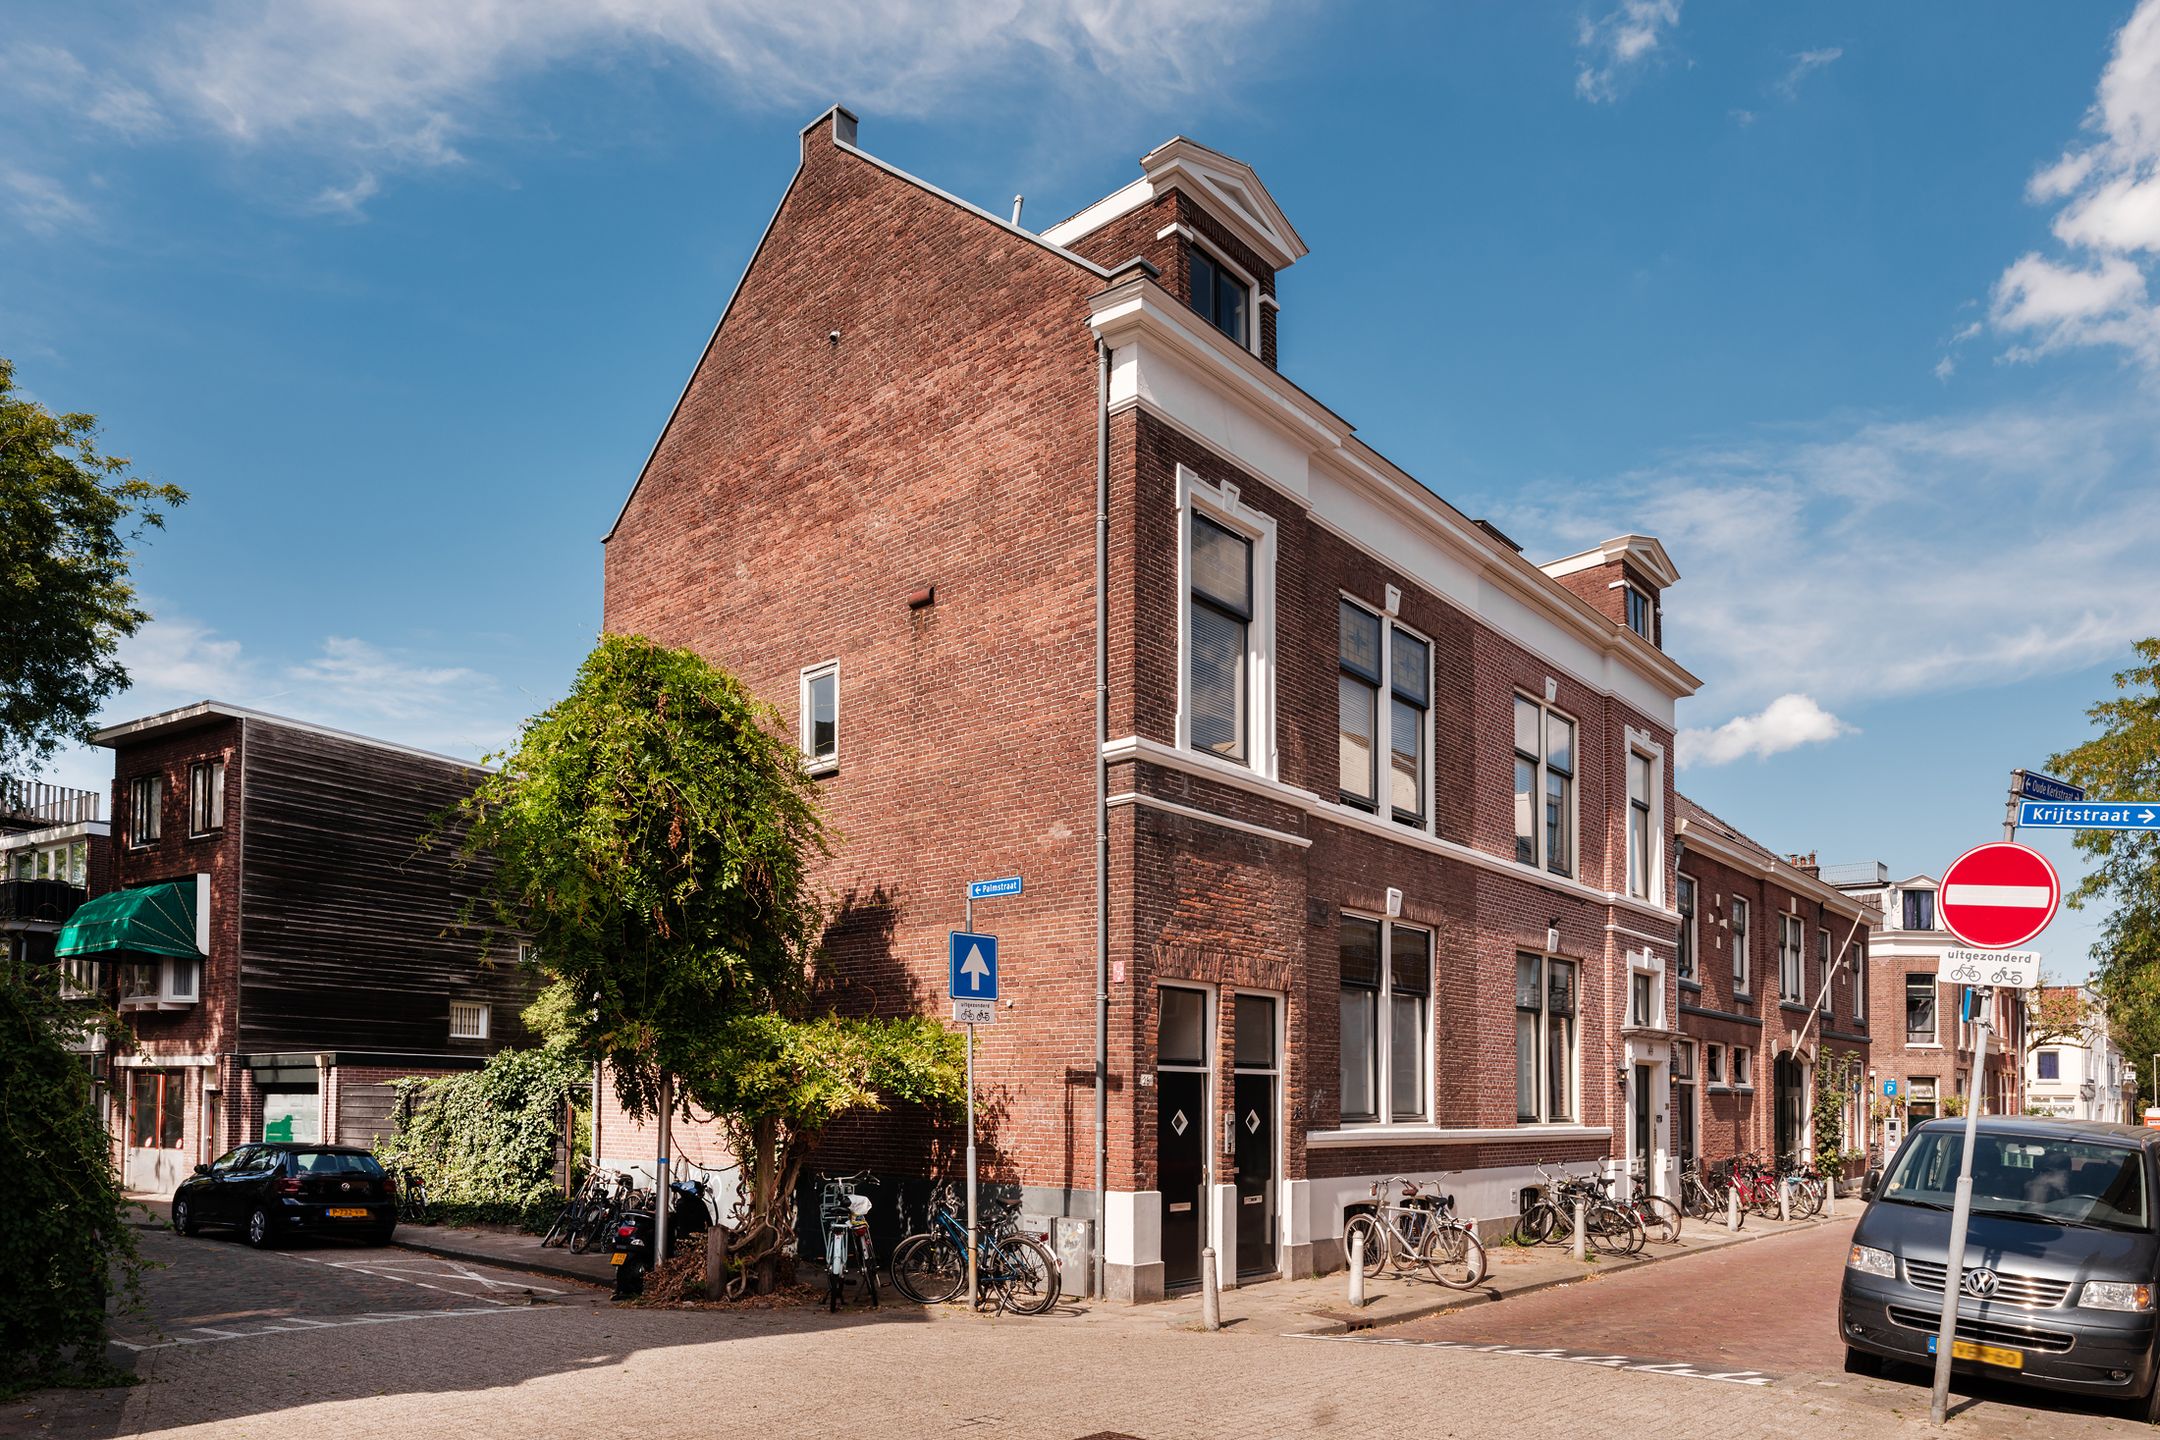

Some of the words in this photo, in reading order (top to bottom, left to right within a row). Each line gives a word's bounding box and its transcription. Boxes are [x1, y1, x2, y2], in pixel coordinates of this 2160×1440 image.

[2032, 779, 2047, 795] Oude
[2046, 784, 2073, 801] Kerkstraat
[2033, 807, 2131, 824] Krijtstraat
[982, 880, 1017, 893] Palmstraat
[1947, 950, 2032, 964] uitgezonderd
